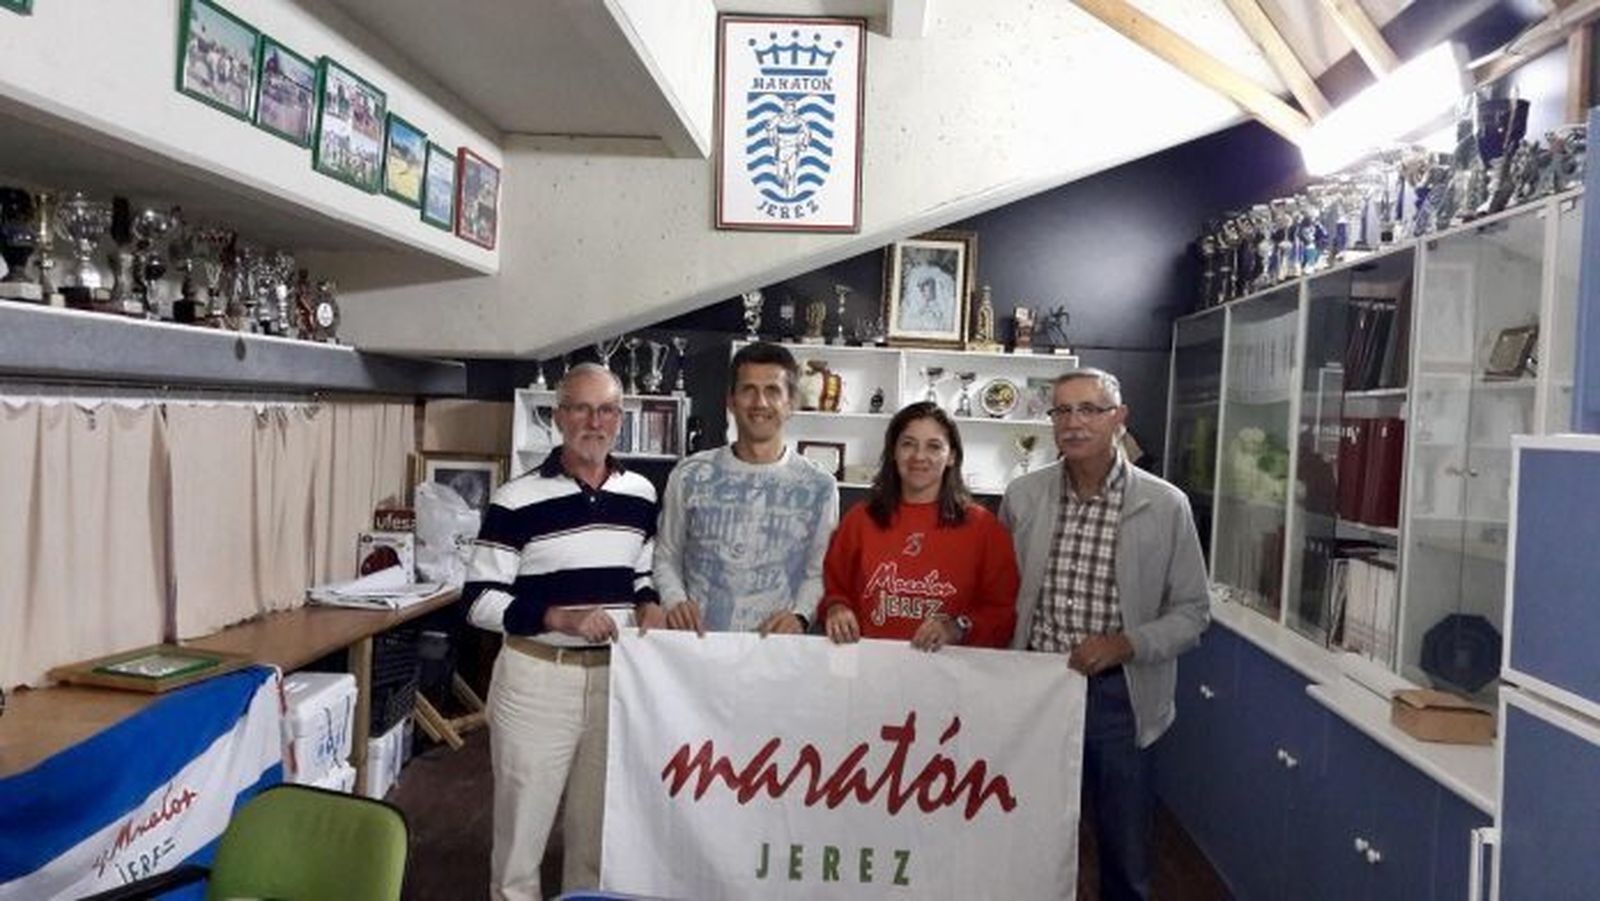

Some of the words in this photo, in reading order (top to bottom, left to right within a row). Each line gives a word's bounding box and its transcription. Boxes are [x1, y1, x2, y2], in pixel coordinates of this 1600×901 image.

[752, 77, 833, 91] MARATON
[756, 199, 820, 219] JEREZ
[871, 590, 949, 626] JEREZ
[661, 710, 1017, 820] maratón
[756, 842, 911, 886] JEREZ
